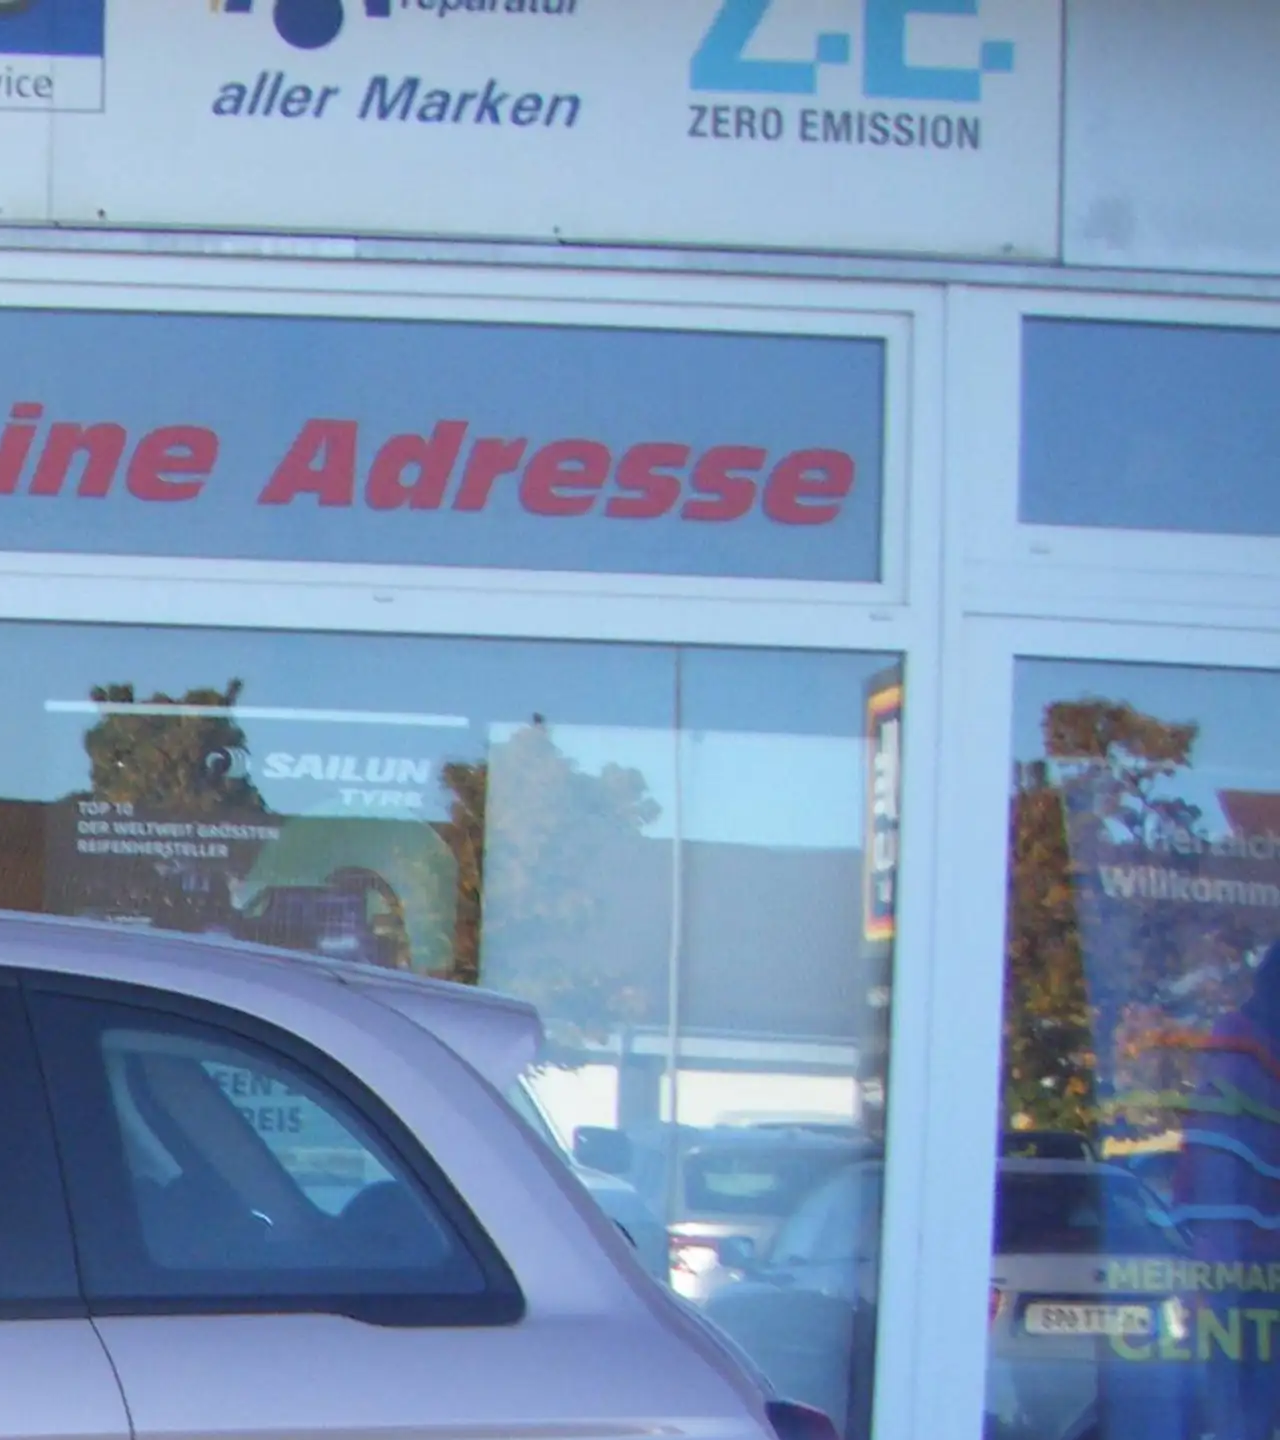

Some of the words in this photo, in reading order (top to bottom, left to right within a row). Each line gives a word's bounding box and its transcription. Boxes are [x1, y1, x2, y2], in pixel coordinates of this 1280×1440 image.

[212, 70, 339, 119] aller
[357, 74, 581, 128] Marken
[688, 105, 783, 141] ZERO
[799, 108, 981, 151] EMISSION
[257, 418, 855, 526] Adresse
[262, 751, 434, 785] SAILUN
